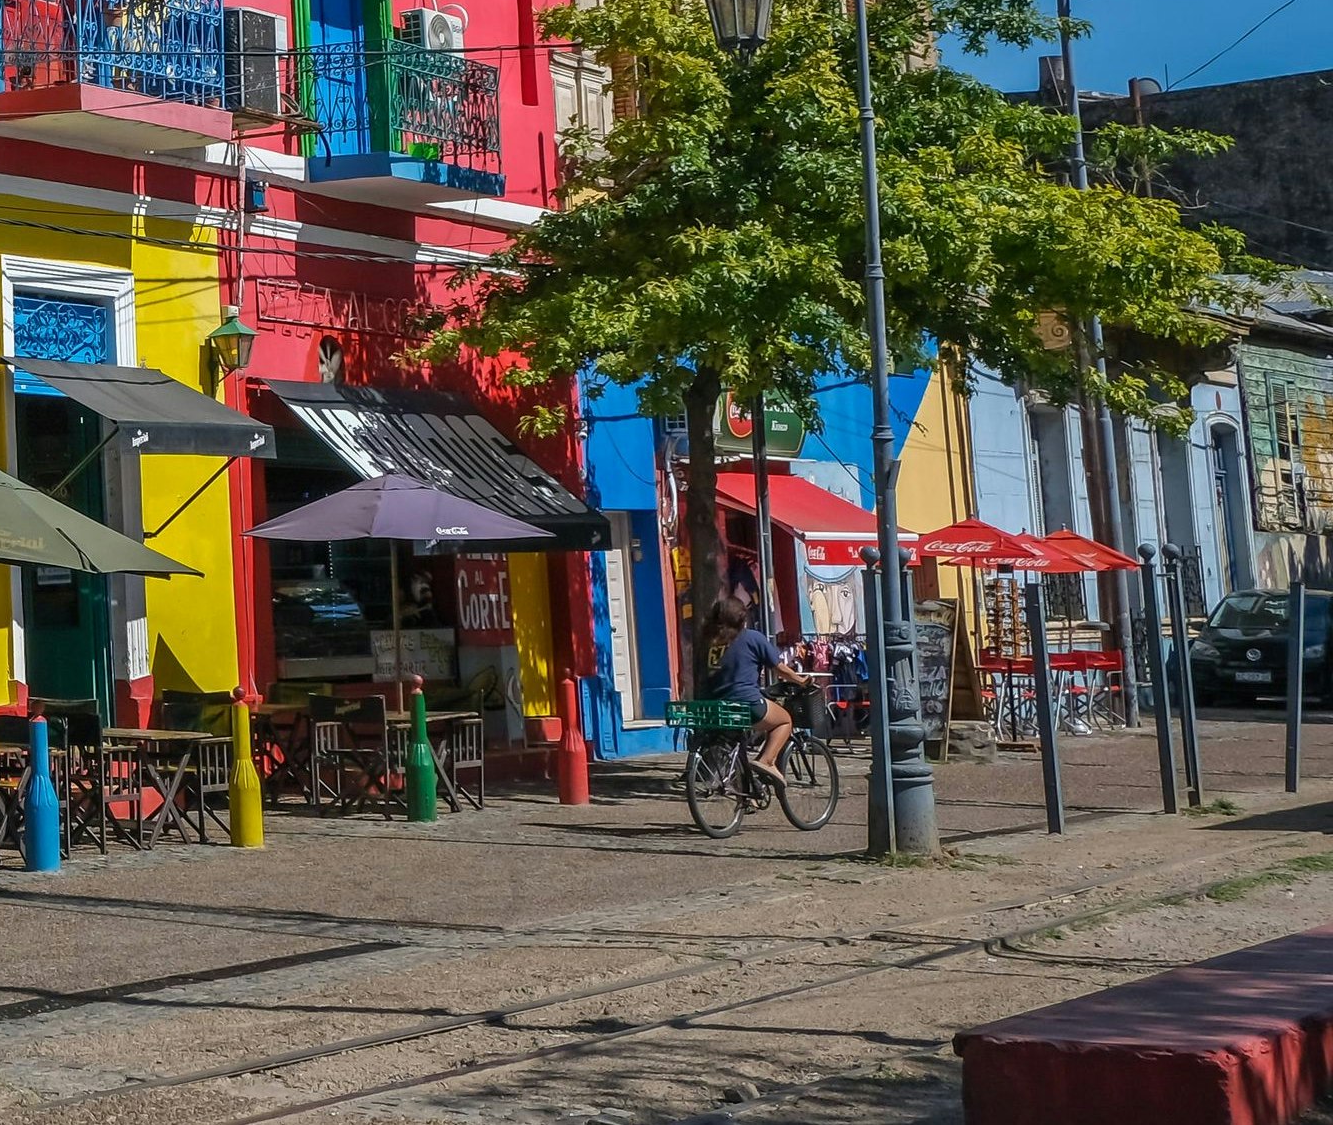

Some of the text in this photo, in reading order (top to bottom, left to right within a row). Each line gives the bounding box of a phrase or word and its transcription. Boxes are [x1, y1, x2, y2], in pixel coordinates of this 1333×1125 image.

[924, 541, 996, 553] Coca-Cola
[475, 571, 484, 585] AL
[457, 569, 511, 630] CORTE
